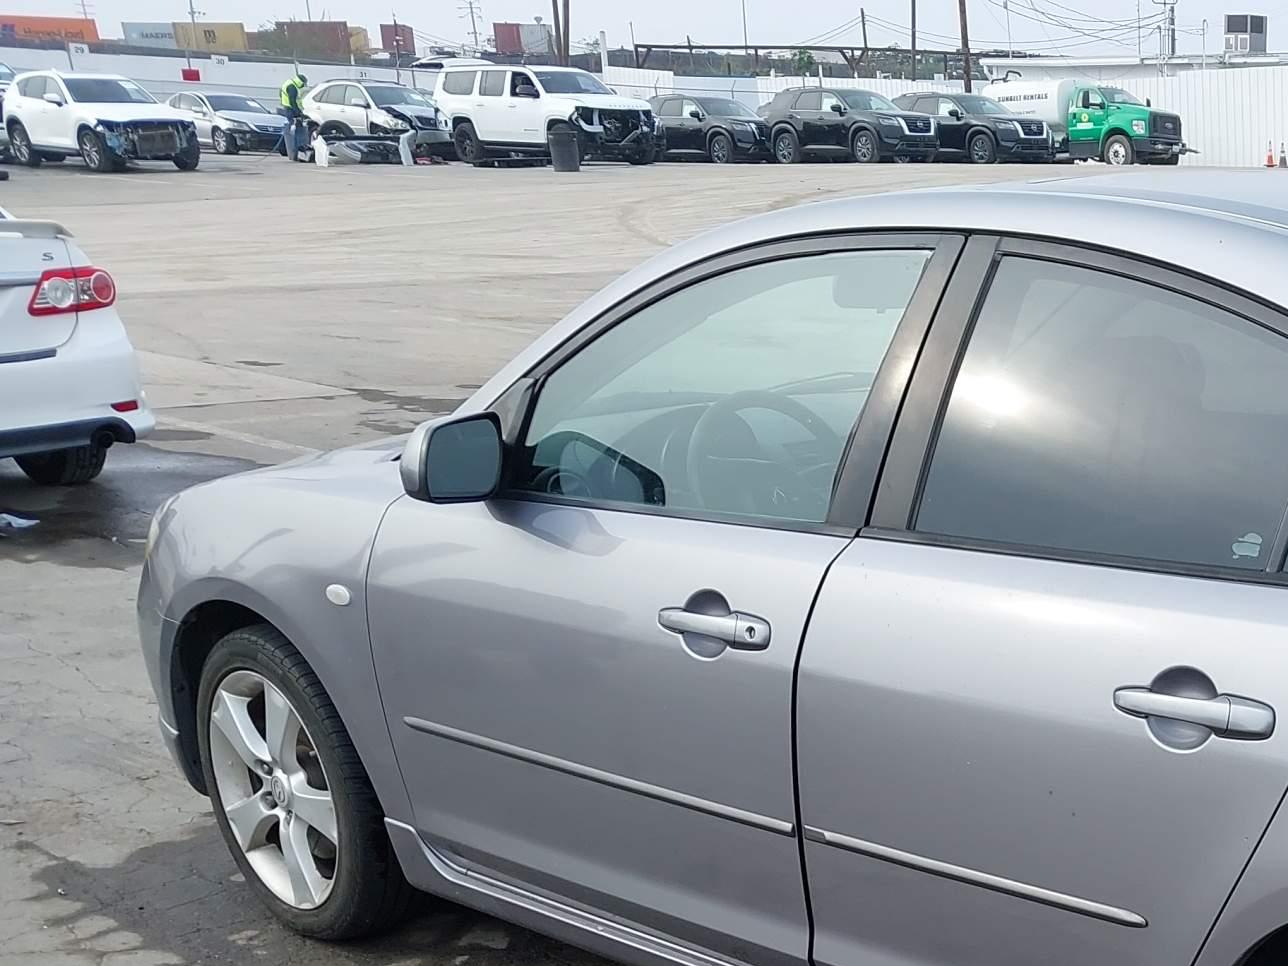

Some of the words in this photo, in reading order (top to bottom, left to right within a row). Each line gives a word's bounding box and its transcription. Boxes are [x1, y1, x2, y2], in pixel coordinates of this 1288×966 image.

[140, 32, 174, 40] MAERS
[74, 46, 84, 54] 29
[215, 57, 225, 65] 30
[1023, 93, 1048, 101] RENTALS
[41, 252, 55, 261] S
